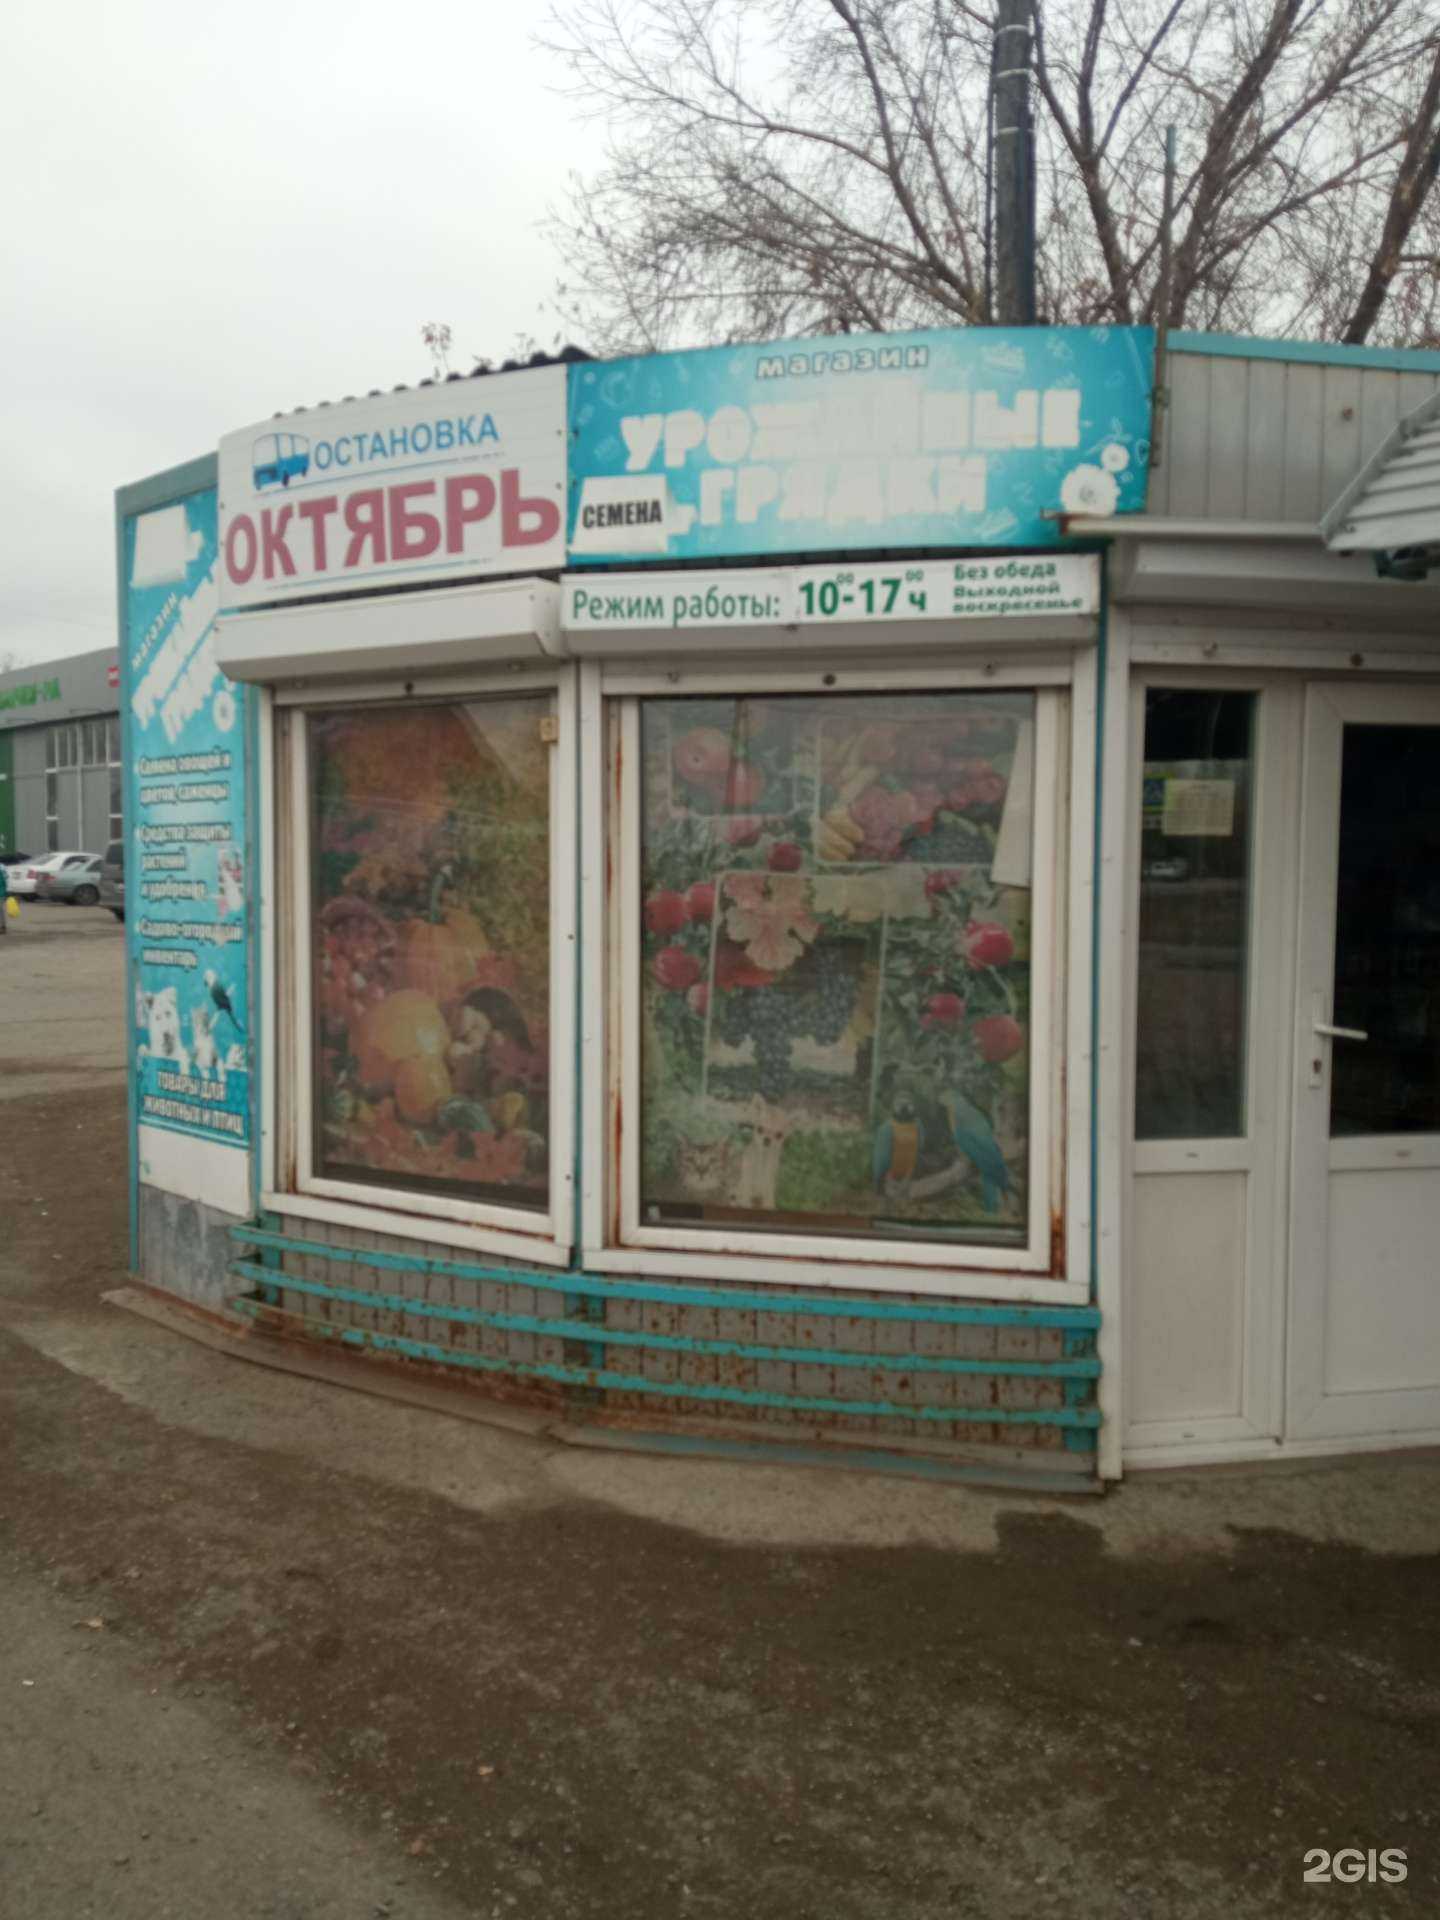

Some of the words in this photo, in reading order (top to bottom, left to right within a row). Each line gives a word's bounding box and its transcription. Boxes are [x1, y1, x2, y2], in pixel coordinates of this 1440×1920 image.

[756, 346, 929, 381] магазин
[314, 413, 499, 470] ОСТАНОВКА
[225, 467, 561, 586] ОКТЯБРЬ
[582, 499, 663, 529] СЕМЕНА
[954, 562, 988, 580] Без
[994, 560, 1057, 579] обеда
[953, 579, 1062, 598] Выходной
[573, 589, 664, 621] Режим
[673, 584, 780, 628] работы:
[953, 597, 1084, 614] воскресенье
